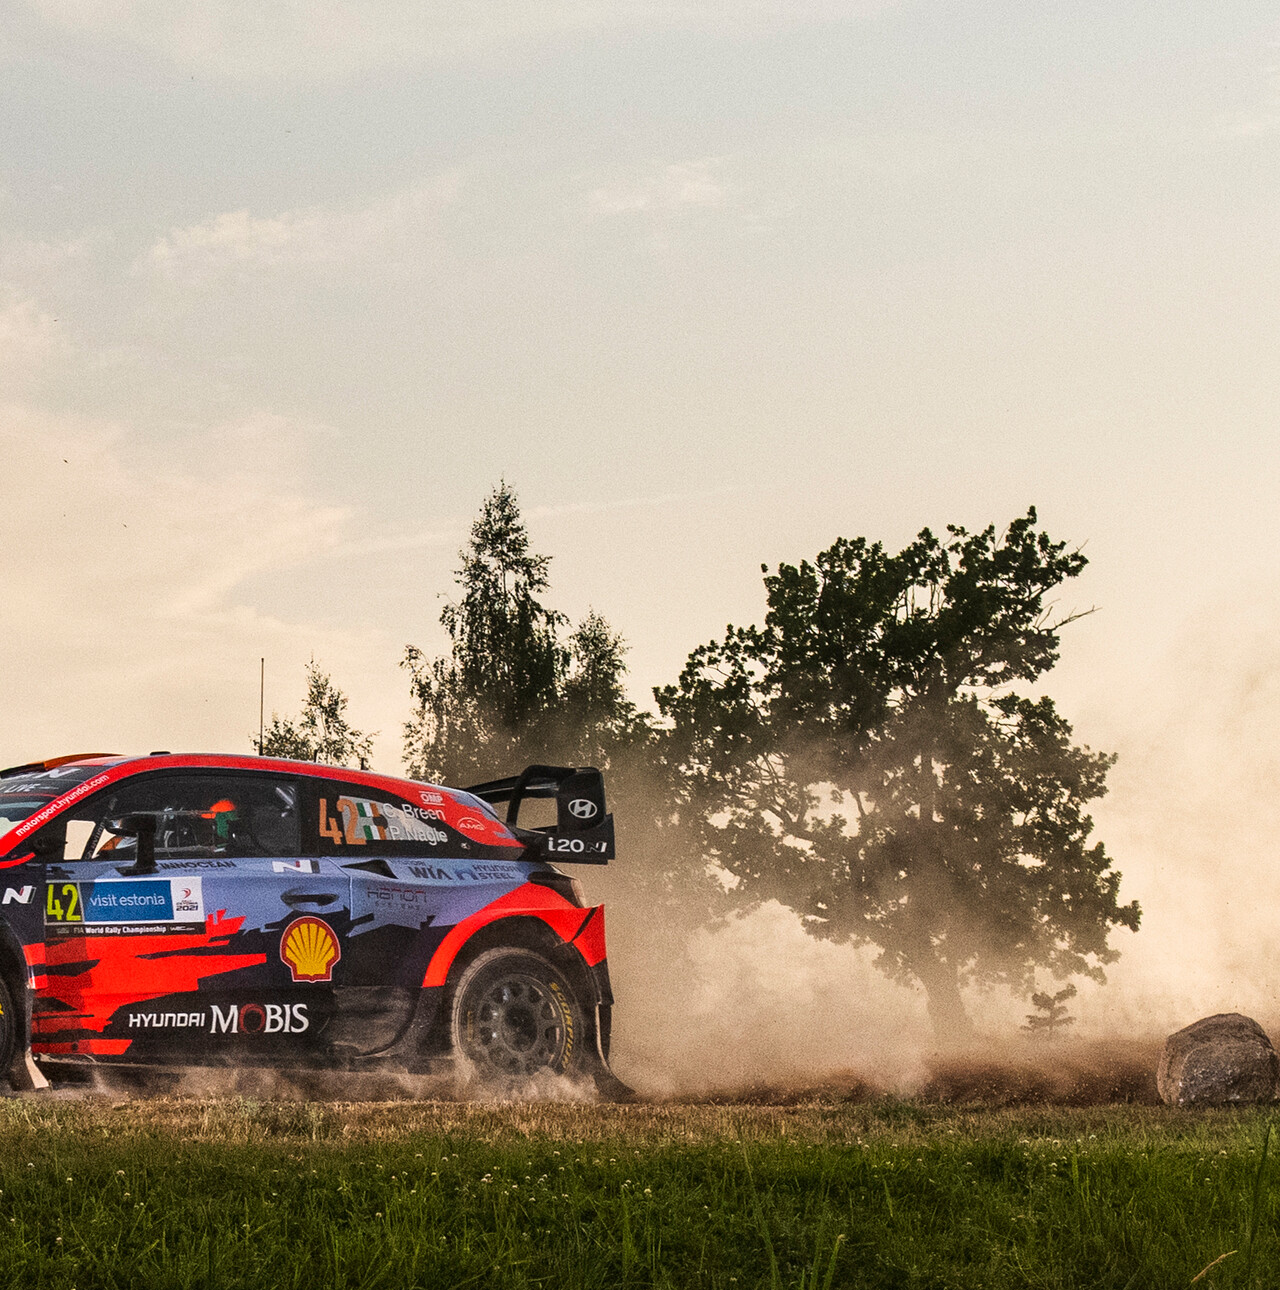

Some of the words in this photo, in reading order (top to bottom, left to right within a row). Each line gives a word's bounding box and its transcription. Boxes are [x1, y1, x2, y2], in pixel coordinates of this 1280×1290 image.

[15, 774, 110, 836] motorsport.hyundai.com
[420, 792, 444, 803] OMP
[401, 803, 447, 820] Breen
[319, 798, 367, 845] 42
[407, 827, 448, 846] Nagle
[548, 837, 585, 852] i20
[160, 860, 237, 869] INNOCEAN
[478, 872, 515, 880] STEEL
[46, 884, 81, 921] 42
[90, 894, 117, 907] visit
[120, 893, 166, 906] estonia
[176, 904, 199, 912] 2021
[85, 926, 104, 934] World
[105, 926, 121, 935] Rally
[123, 925, 167, 935] Championship
[128, 1012, 206, 1028] HYUNDAI
[210, 1003, 310, 1034] MOBIS
